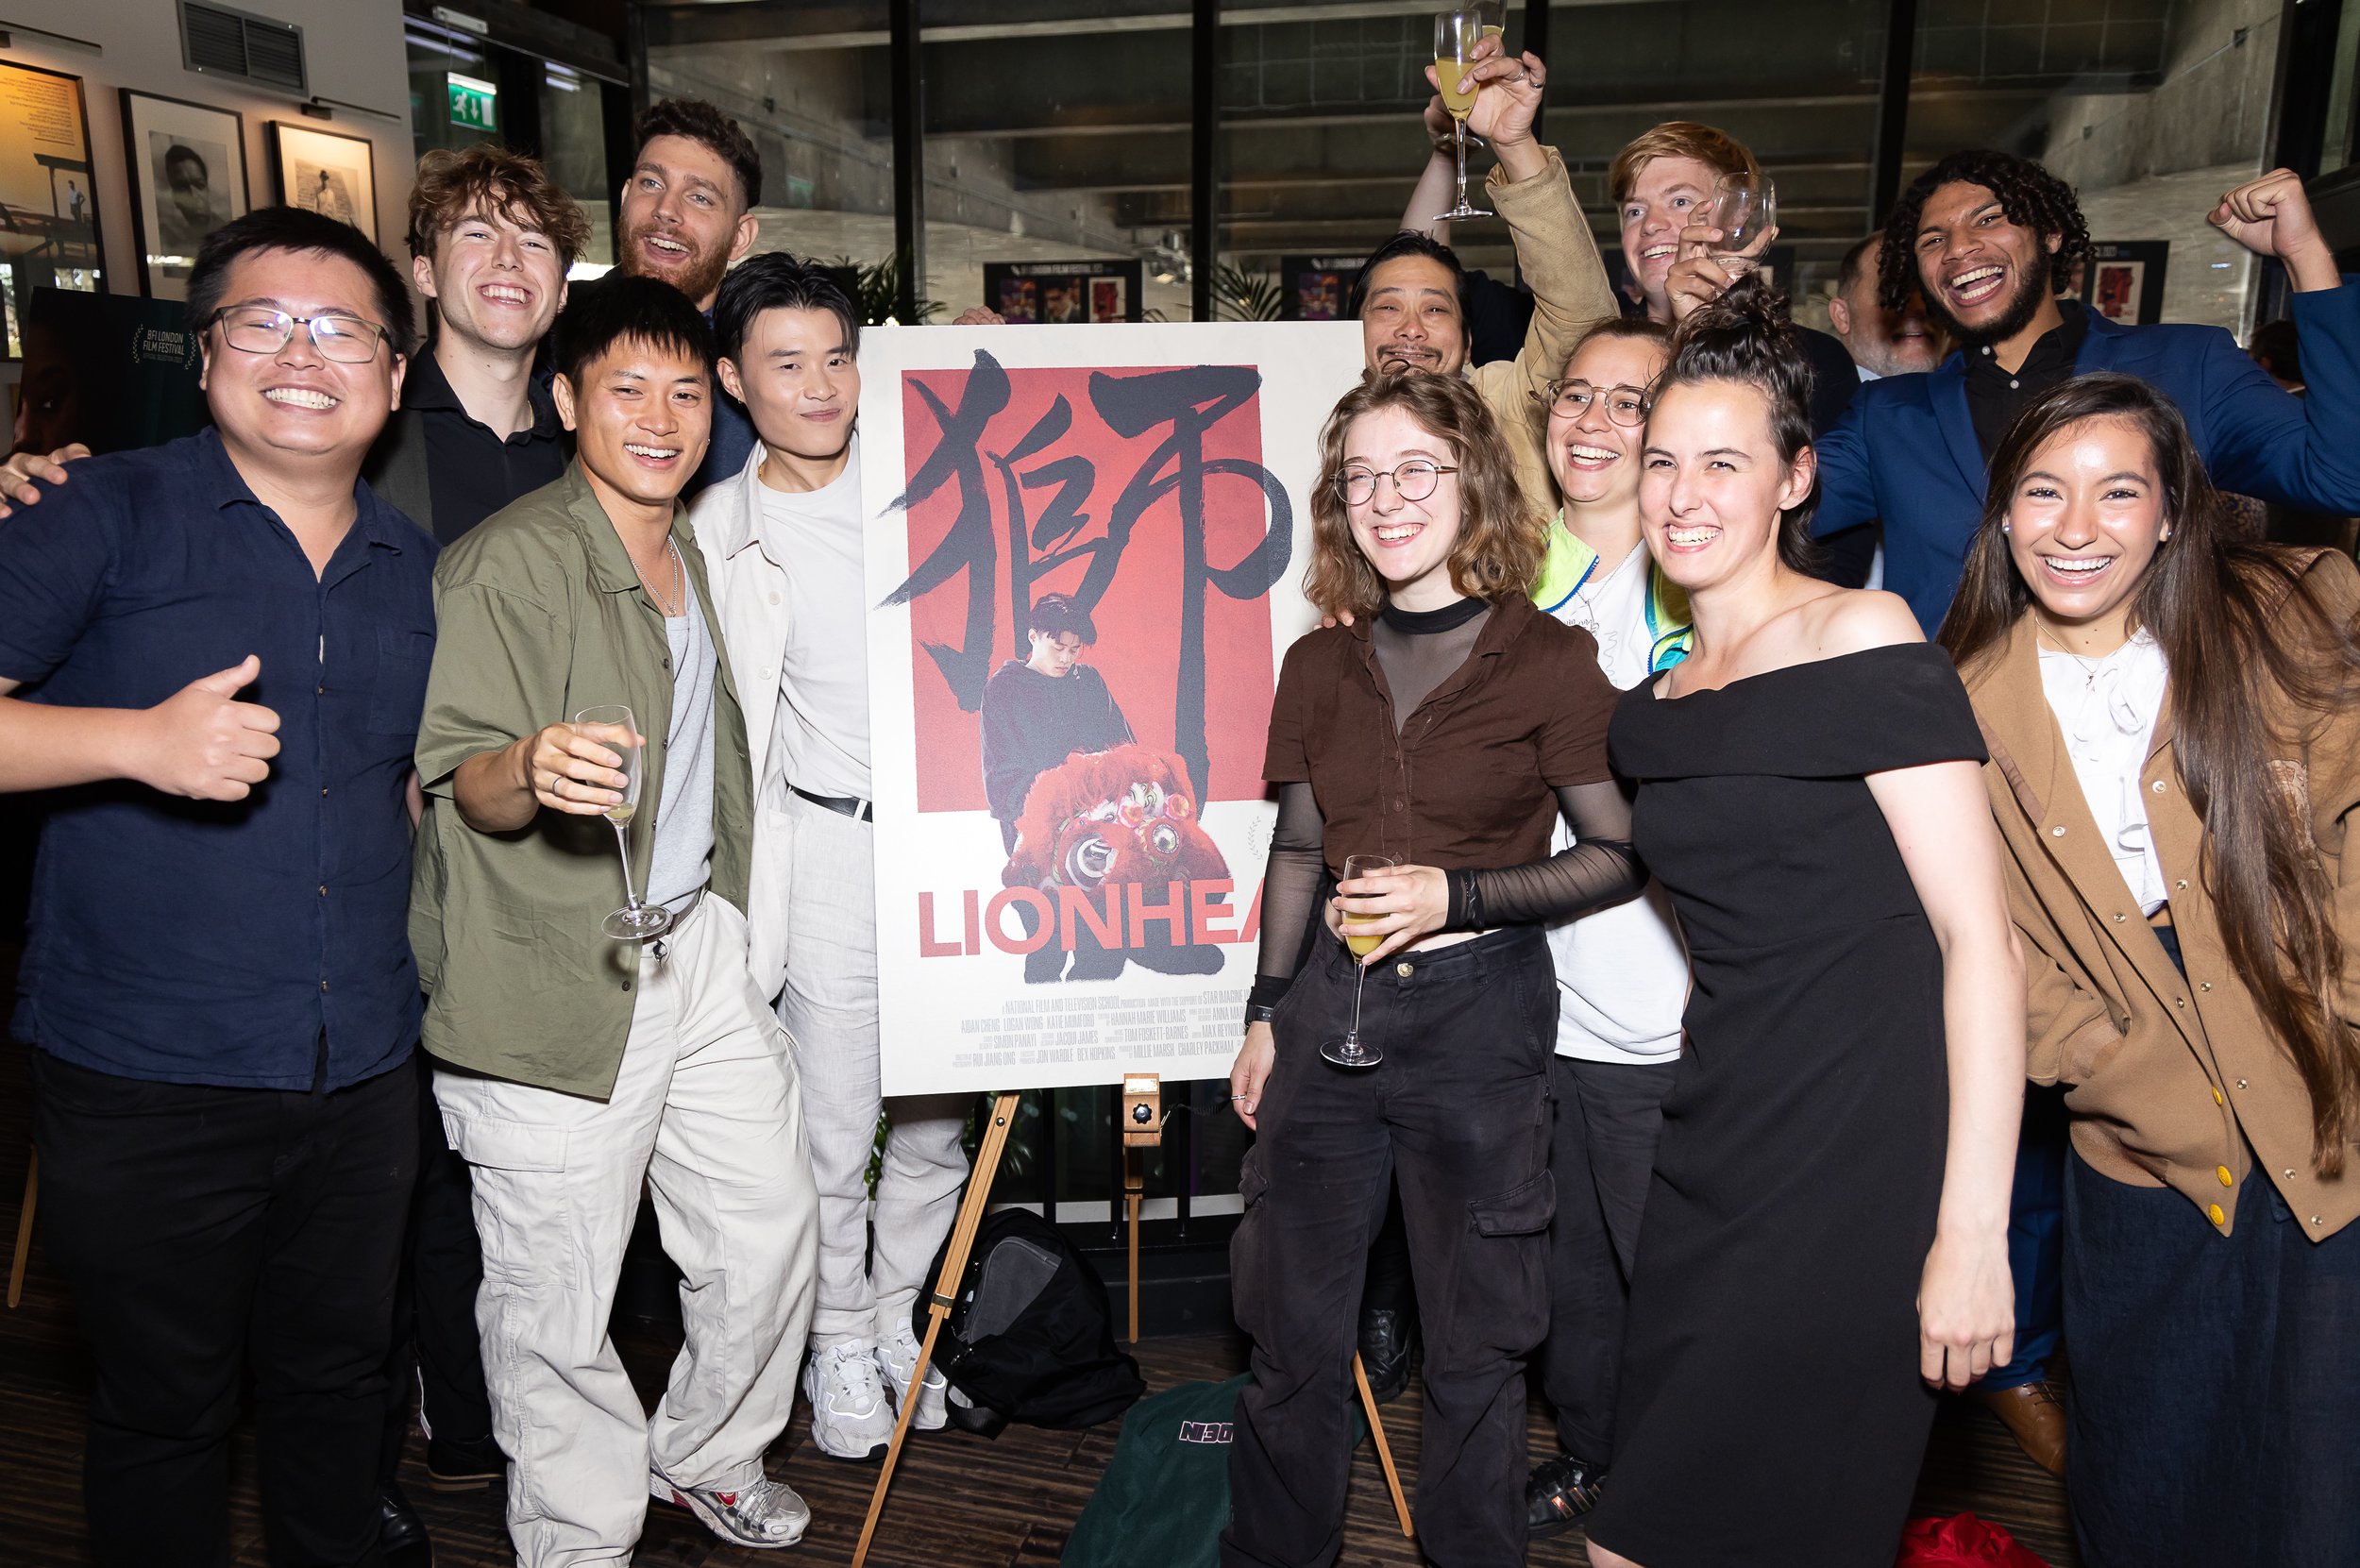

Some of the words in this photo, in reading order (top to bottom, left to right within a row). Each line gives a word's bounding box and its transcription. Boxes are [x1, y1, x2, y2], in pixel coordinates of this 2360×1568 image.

[147, 329, 157, 340] BFI
[159, 331, 183, 344] LONDON
[143, 340, 157, 351] FILM
[158, 342, 184, 355] FESTIVAL
[1005, 1000, 1036, 1014] NATIONAL
[1036, 999, 1050, 1013] FILM
[1051, 998, 1064, 1012] AND
[1065, 996, 1097, 1012] TELEVISION
[1098, 996, 1121, 1010] SCHOOL
[1203, 991, 1219, 1004] STAR
[1110, 1011, 1136, 1026] HANNAH
[1137, 1010, 1155, 1024] MARIE
[1156, 1009, 1186, 1023] WILLIAMS
[1212, 1007, 1229, 1020] ANNA
[961, 1019, 980, 1034] AIDAN
[981, 1018, 1000, 1033] CHENG
[1003, 1017, 1024, 1031] LOGAN
[1047, 1015, 1064, 1029] KATIE
[1055, 1032, 1077, 1045] JACQUI
[1077, 1030, 1098, 1044] JAMES
[1124, 1029, 1138, 1042] TOM
[1138, 1026, 1188, 1041] FOSKETT-BARNES
[1202, 1024, 1217, 1037] MAX
[994, 1035, 1014, 1049] SIMON
[1015, 1034, 1037, 1048] PANAYI
[1178, 1041, 1203, 1056] CHARLEY
[1204, 1040, 1234, 1054] PACKHAM
[1036, 1050, 1048, 1064] JON
[1077, 1048, 1088, 1062] BEX
[1090, 1046, 1116, 1060] HOPKINS
[1133, 1043, 1152, 1058] MILLIE
[1153, 1042, 1174, 1057] MARSH
[973, 1054, 983, 1067] RUI
[984, 1053, 1003, 1066] JIANG
